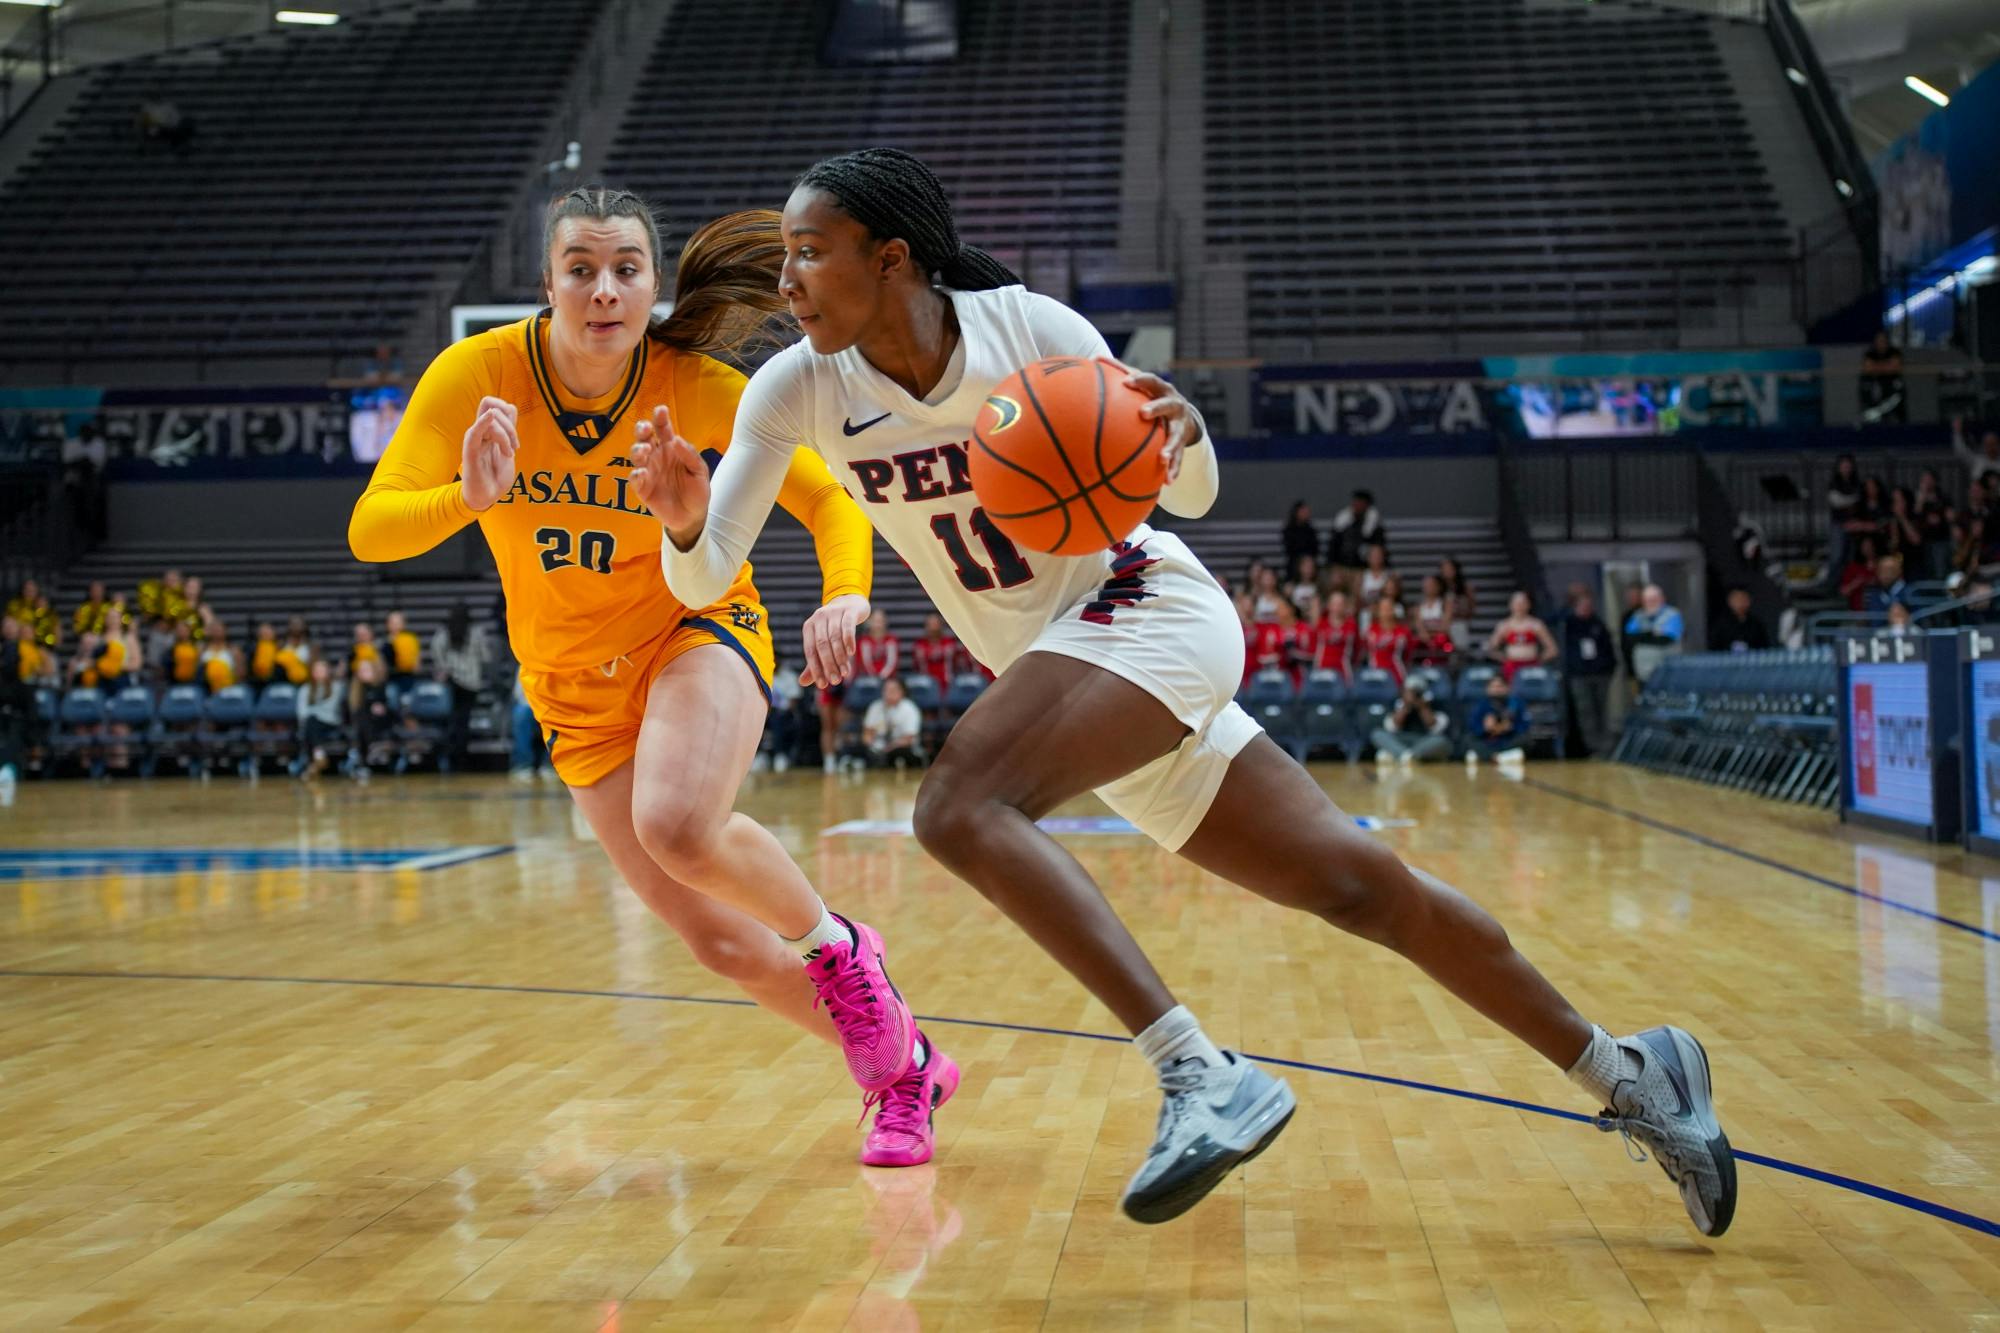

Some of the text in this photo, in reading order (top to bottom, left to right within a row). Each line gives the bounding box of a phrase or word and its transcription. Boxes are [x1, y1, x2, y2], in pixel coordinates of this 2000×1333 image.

[1293, 381, 1484, 434] NOA
[497, 471, 655, 517] ASALL
[848, 440, 974, 503] PEN
[535, 526, 616, 575] 20
[930, 506, 1034, 592] 11
